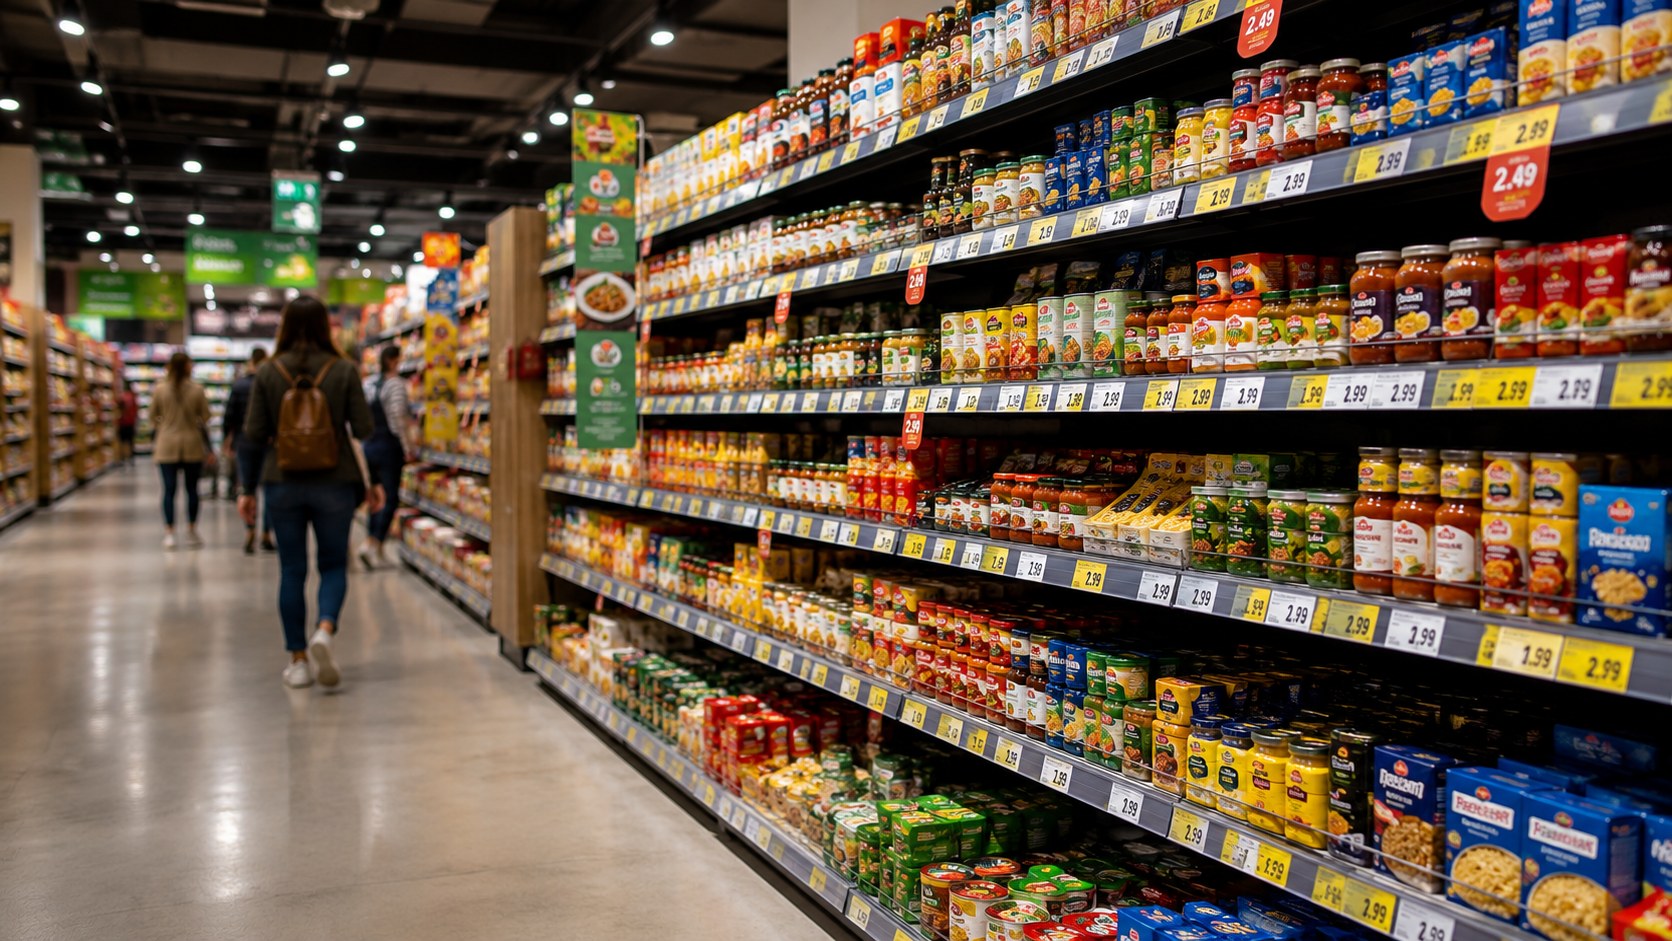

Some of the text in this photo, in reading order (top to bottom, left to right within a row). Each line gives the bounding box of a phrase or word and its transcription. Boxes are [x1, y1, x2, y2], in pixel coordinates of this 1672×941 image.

[1245, 8, 1274, 36] 2.49
[1376, 152, 1402, 174] 2.99
[1283, 173, 1305, 192] 2.99
[1493, 162, 1538, 192] 2.49
[1210, 188, 1230, 206] 2.99
[1112, 210, 1128, 226] 2.99
[1103, 392, 1120, 406] 2.99
[1156, 391, 1173, 406] 2.99
[1192, 389, 1210, 405] 2.99
[1344, 384, 1367, 402] 2.99
[1391, 384, 1416, 402] 2.99
[1498, 381, 1527, 400] 2.99
[1085, 572, 1102, 586] 2.99
[1152, 583, 1170, 600] 2.99
[1192, 589, 1212, 606] 2.99
[1286, 604, 1308, 624] 2.99
[1346, 615, 1370, 635] 2.99
[1521, 645, 1552, 668] 1.99
[1586, 657, 1621, 681] 2.99
[1122, 798, 1138, 816] 2.99
[1185, 824, 1202, 844] 2.99
[1363, 898, 1386, 923] 2.99
[1418, 922, 1445, 941] 299
